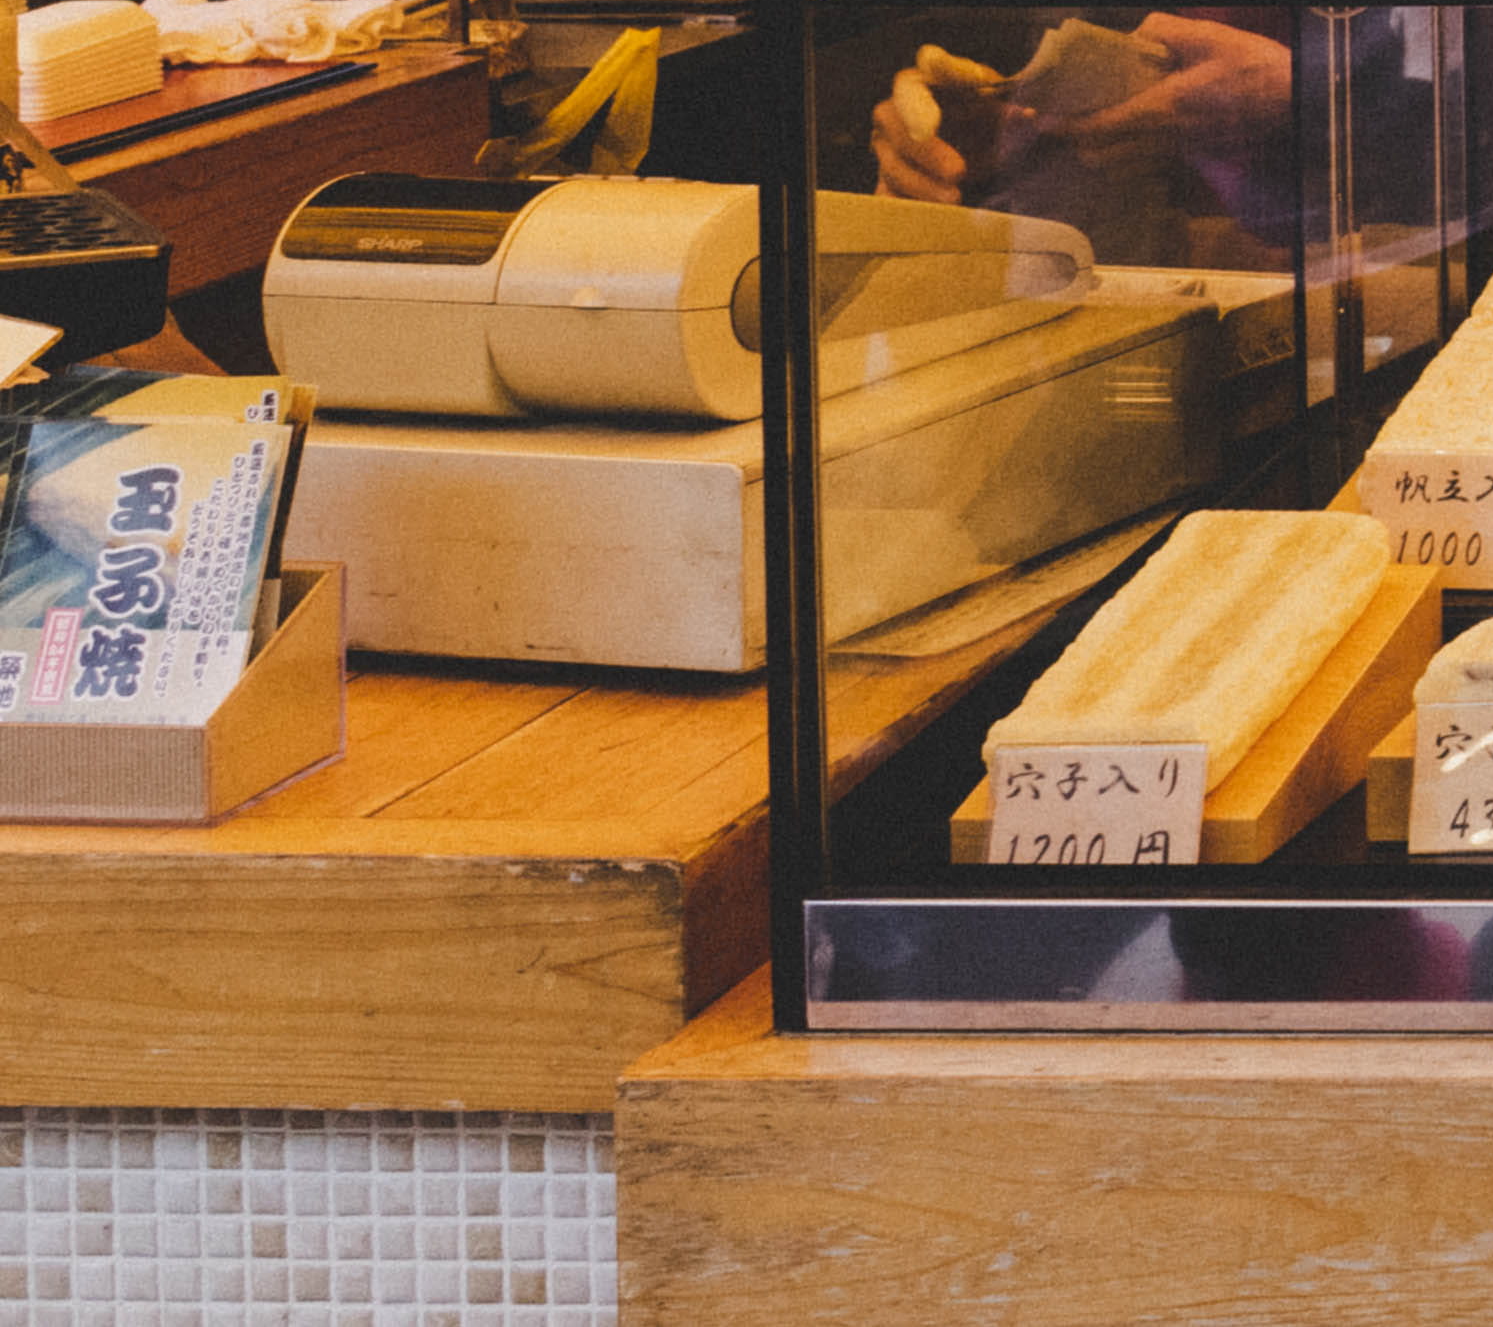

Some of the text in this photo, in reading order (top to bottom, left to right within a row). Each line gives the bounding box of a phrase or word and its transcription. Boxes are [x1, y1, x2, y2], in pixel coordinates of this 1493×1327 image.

[357, 236, 424, 251] SHARP
[73, 466, 182, 699] 玉子焼
[1007, 758, 1179, 800] 穴子入り
